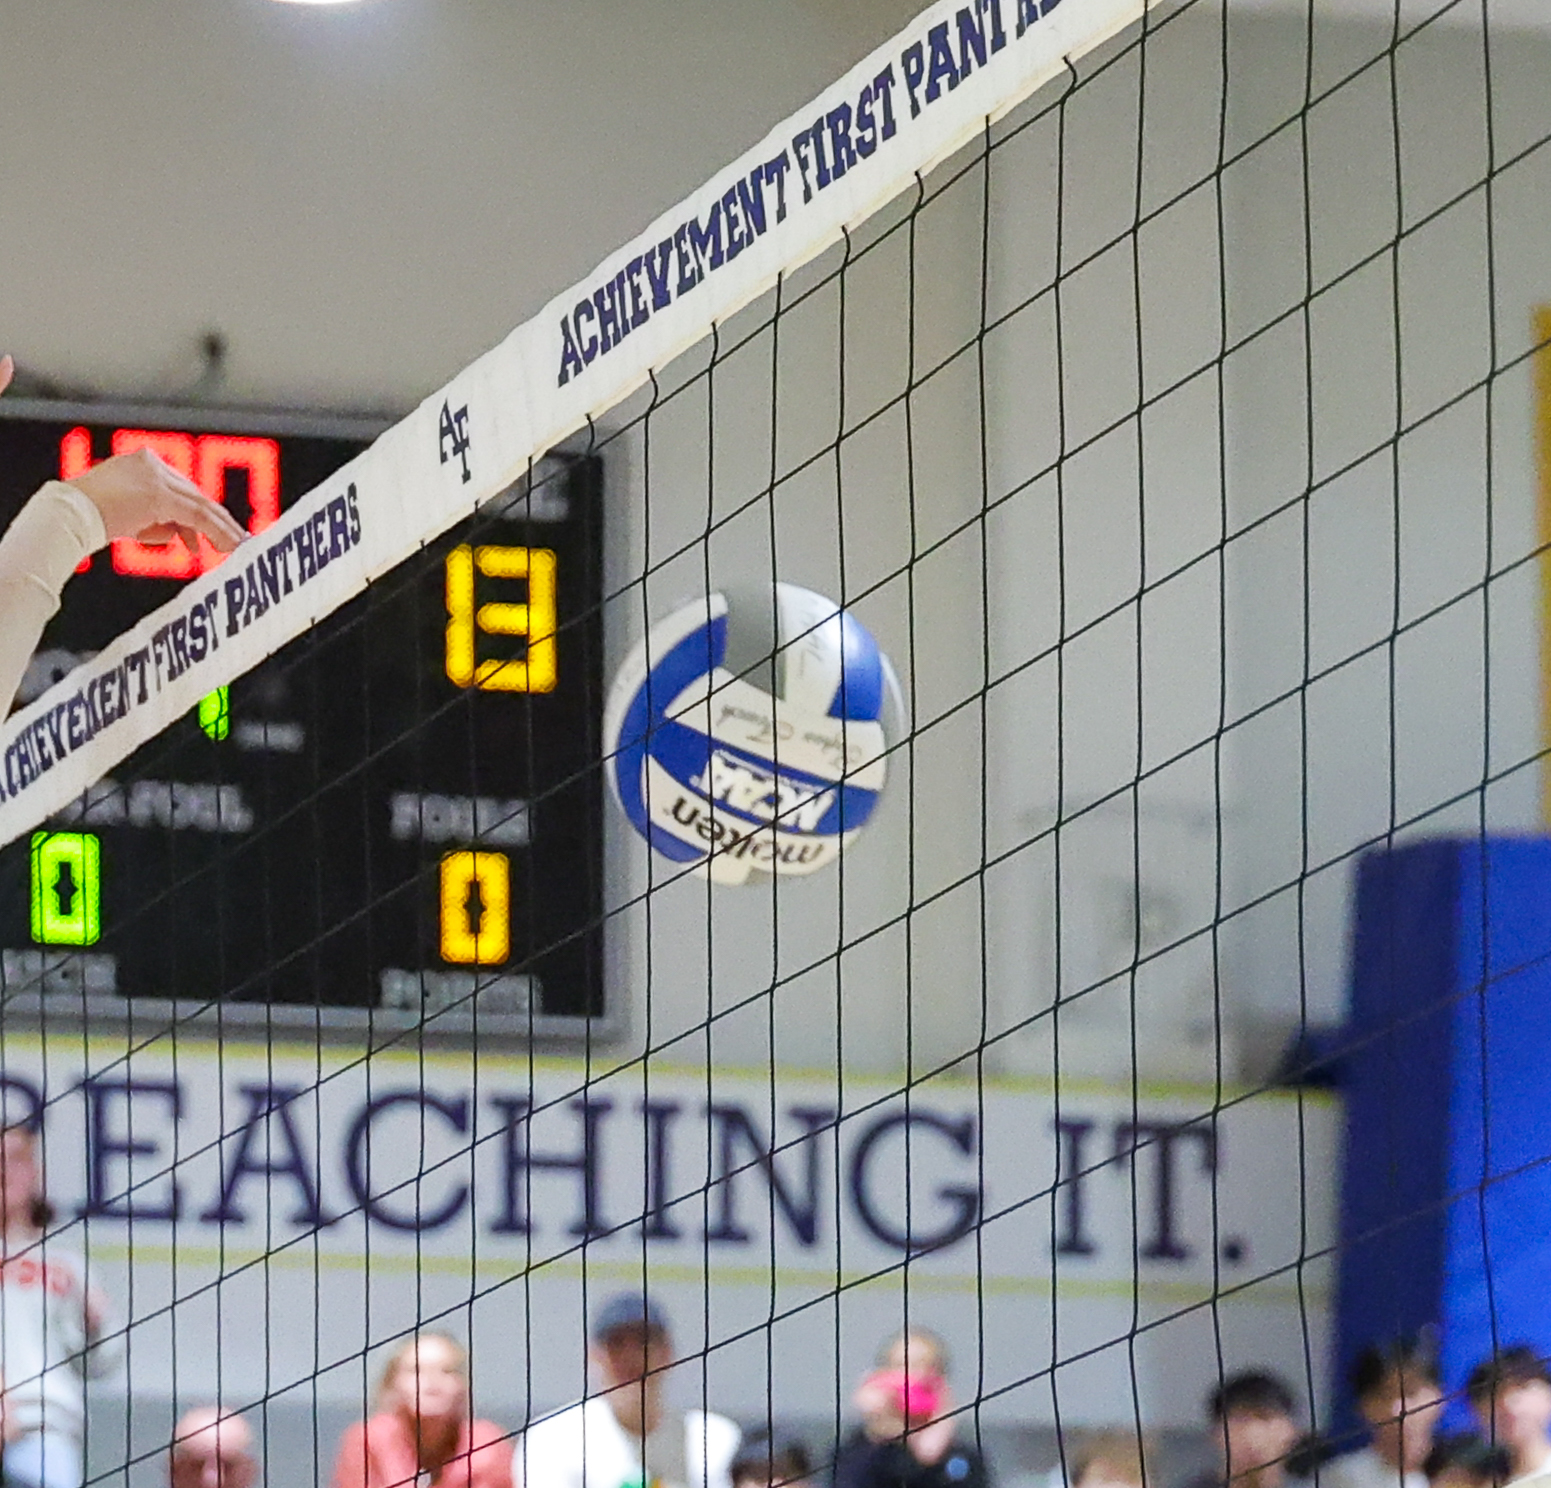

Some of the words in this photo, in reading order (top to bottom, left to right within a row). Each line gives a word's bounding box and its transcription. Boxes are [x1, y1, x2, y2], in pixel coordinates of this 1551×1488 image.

[557, 148, 793, 388] ACHIEVEMENT
[792, 61, 896, 204] FIRST
[150, 589, 219, 692] FIRST
[225, 482, 362, 638] PANTHERS
[30, 831, 101, 946] 0
[669, 797, 826, 865] molten
[438, 850, 510, 966] 0
[1050, 1115, 1246, 1264] IT.
